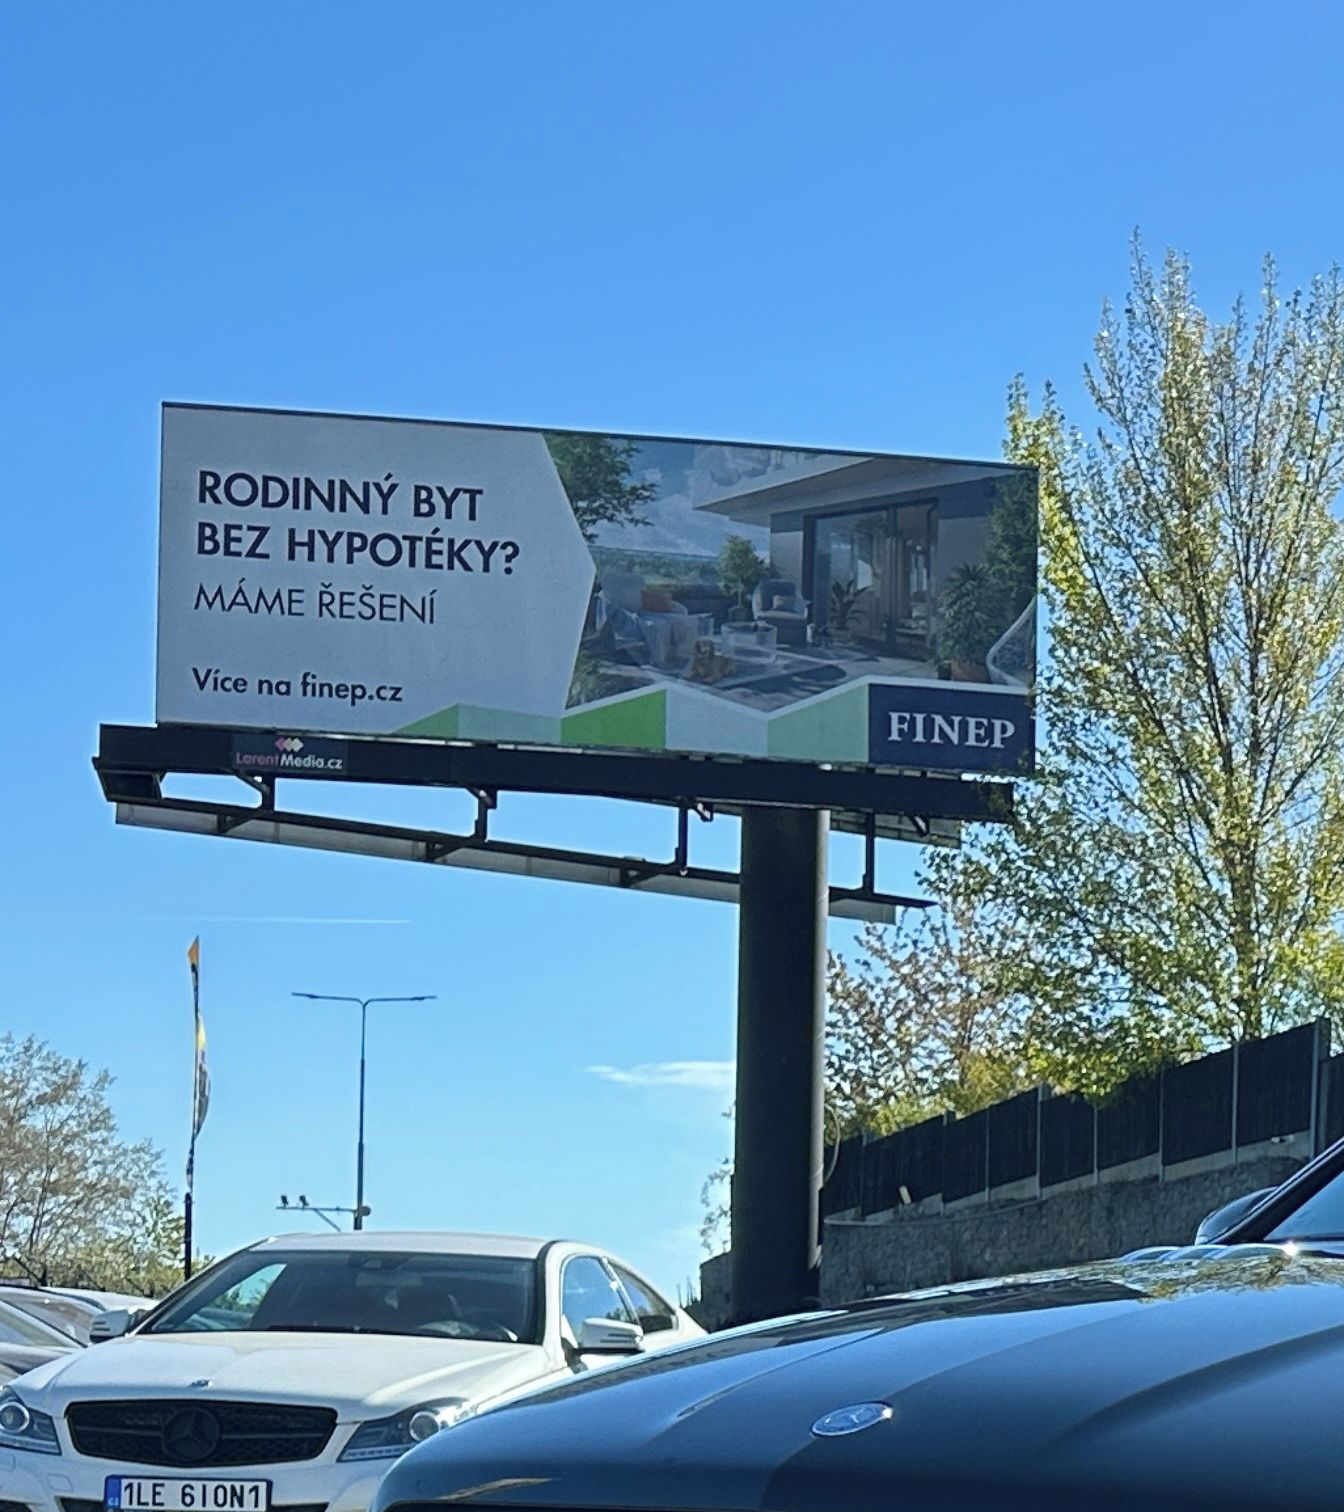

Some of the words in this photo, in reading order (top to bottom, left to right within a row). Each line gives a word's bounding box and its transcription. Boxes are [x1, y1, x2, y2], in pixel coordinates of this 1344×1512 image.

[198, 470, 399, 516] RODINNÝ
[413, 484, 483, 521] BYT
[197, 521, 270, 560] BEZ
[287, 526, 520, 575] HYPOTÉKY?
[193, 577, 305, 617] MÁME
[318, 581, 438, 625] ŘEŠENÍ
[192, 667, 248, 693] Více
[257, 678, 291, 696] na
[301, 671, 403, 707] finep.cz
[888, 711, 1015, 749] FINEP
[124, 1482, 165, 1507] 1LE
